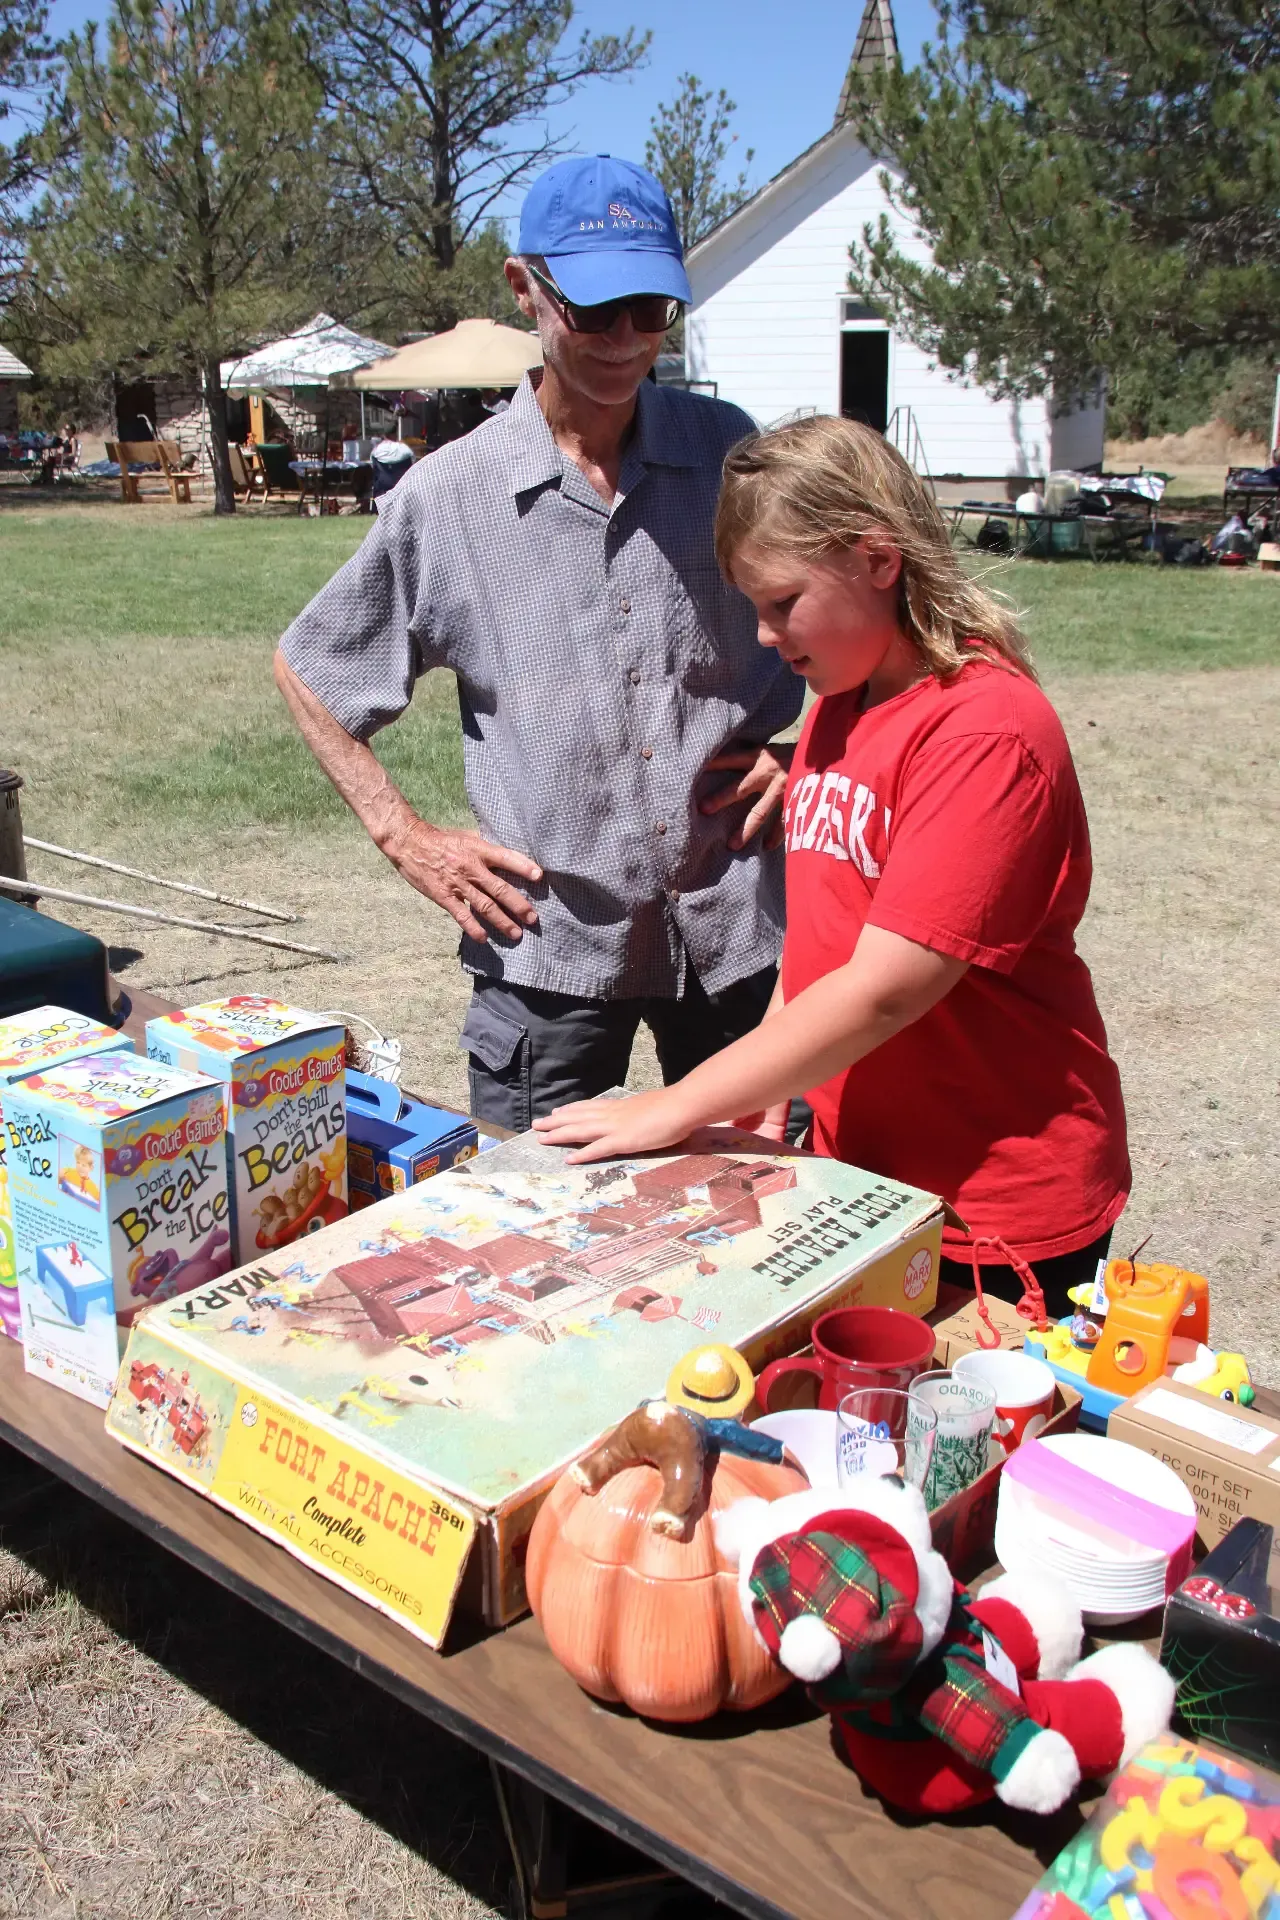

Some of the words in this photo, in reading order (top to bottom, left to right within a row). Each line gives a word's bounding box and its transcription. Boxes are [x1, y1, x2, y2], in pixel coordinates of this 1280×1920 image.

[579, 220, 604, 231] SAN
[612, 219, 665, 232] ANTONIO
[608, 203, 633, 220] SA
[12, 1017, 91, 1048] Cootie
[217, 1010, 299, 1032] Beans
[82, 1078, 161, 1100] Break
[269, 1065, 304, 1095] Cootie
[307, 1053, 342, 1081] Games
[5, 1112, 58, 1149] Break
[253, 1097, 297, 1143] Don't
[297, 1085, 330, 1118] Spill
[283, 1118, 302, 1137] the
[144, 1127, 182, 1161] Cootie
[186, 1112, 223, 1144] Games
[238, 1101, 346, 1193] Beans
[25, 1149, 53, 1179] Ice
[112, 1148, 218, 1253] Break
[135, 1167, 174, 1202] Don't
[164, 1219, 187, 1238] the
[182, 1190, 229, 1244] Ice
[801, 1195, 844, 1223] PLAY
[839, 1184, 914, 1229] FORT
[767, 1221, 804, 1244] SET
[751, 1217, 862, 1287] APACHE
[169, 1266, 280, 1321] MARX
[904, 1263, 930, 1289] MARX
[259, 1417, 327, 1484] FORT
[326, 1460, 443, 1557] APACHE
[1161, 1454, 1182, 1471] PC
[1185, 1464, 1220, 1486] GIFT
[1222, 1480, 1253, 1501] SET
[429, 1500, 465, 1533] 3681
[1192, 1484, 1245, 1516] 001H8L
[302, 1496, 367, 1548] Complete
[279, 1515, 304, 1541] ALL
[308, 1538, 423, 1617] ACCESSORIES
